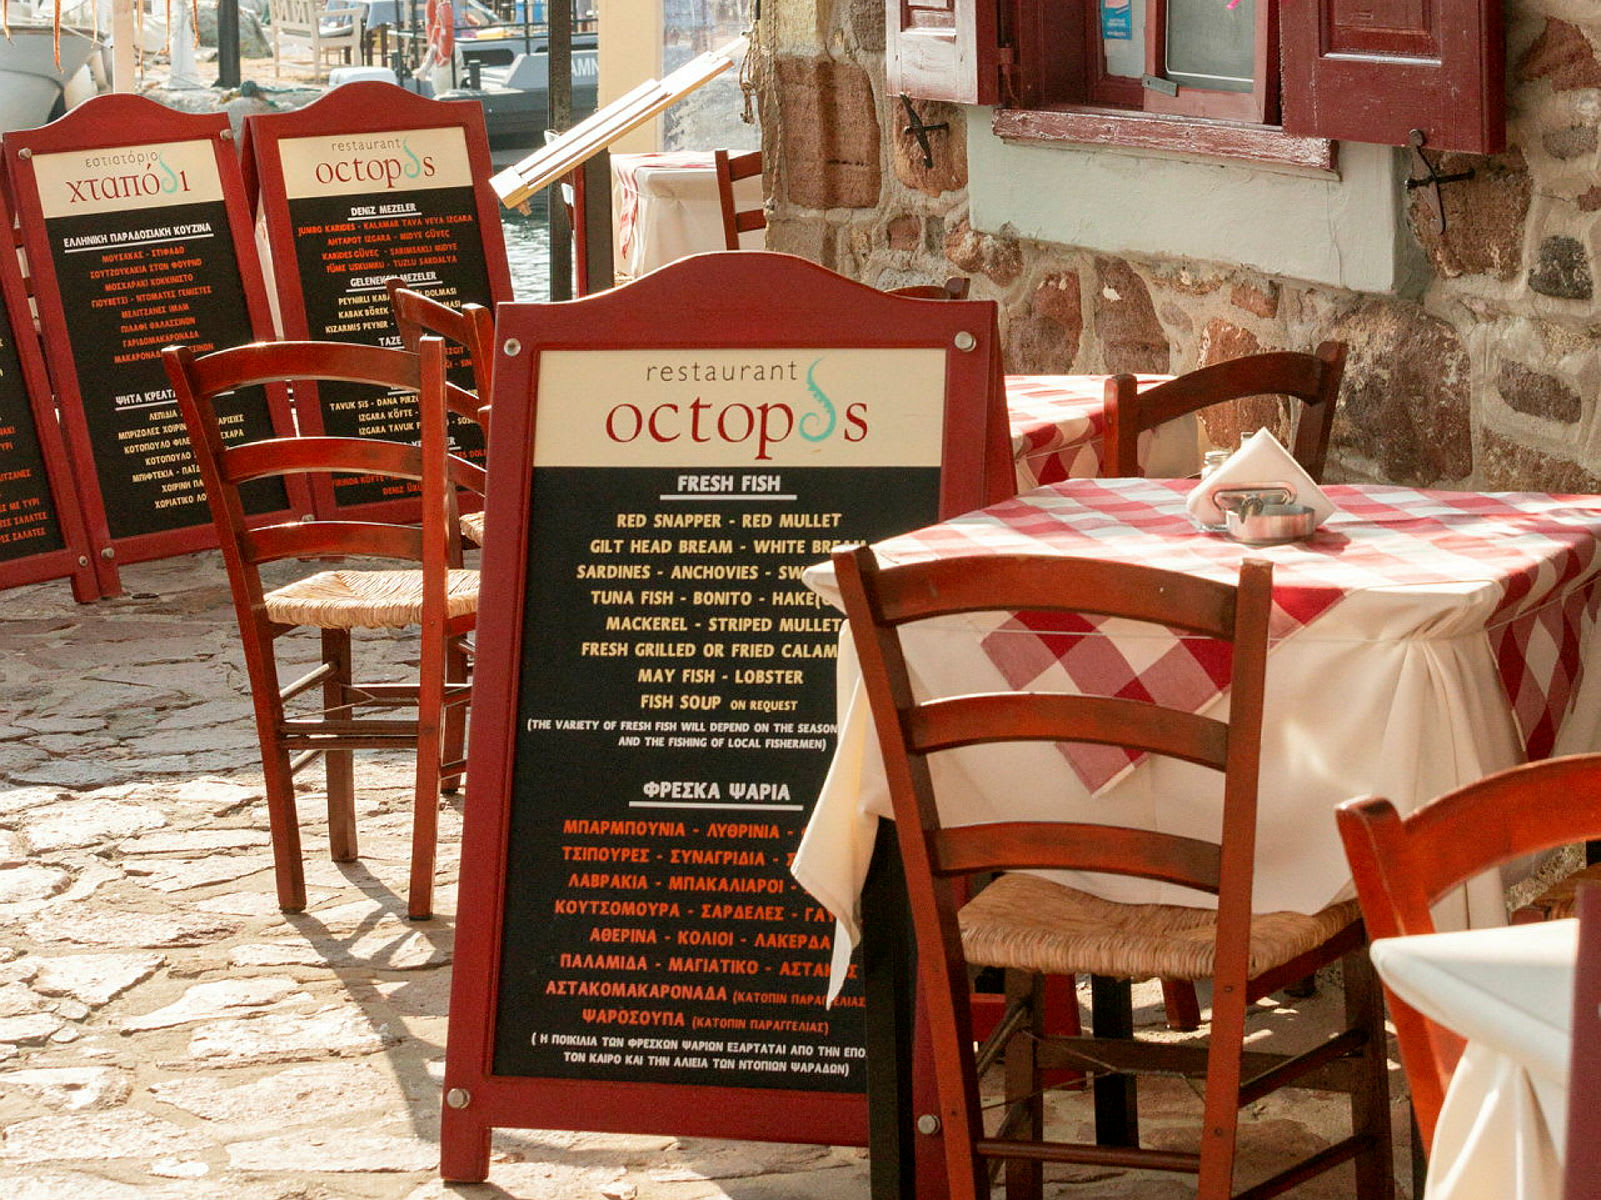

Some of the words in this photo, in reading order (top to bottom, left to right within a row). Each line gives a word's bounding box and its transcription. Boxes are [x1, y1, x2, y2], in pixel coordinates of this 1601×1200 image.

[331, 138, 402, 152] restaurant
[379, 202, 417, 214] MEZELER
[63, 234, 108, 248] ΕΛΛΗΝΙΚΗ
[109, 226, 172, 243] ΠΑΡΑΔΟΣΙΑΚΗ
[173, 222, 212, 236] ΚΟΥΖΙΝΑ
[646, 360, 798, 382] restaurant
[677, 474, 734, 492] FRESH
[741, 474, 781, 492] FISH
[616, 513, 647, 528] RED
[653, 513, 722, 528] SNAPPER
[742, 513, 773, 528] RED
[779, 512, 842, 529] MULLET
[590, 539, 625, 554] GILT
[630, 539, 673, 554] HEAD
[678, 539, 733, 554] BREAM
[753, 539, 806, 554] WHITE
[576, 564, 651, 580] SARDINES
[670, 565, 759, 580] ANCHOVIES
[590, 590, 635, 605] TUNA
[640, 590, 674, 605] FISH
[692, 591, 753, 606] BONITO
[605, 616, 688, 632] MACKEREL
[708, 617, 773, 632] STRIPED
[779, 617, 843, 633] MULLET
[581, 641, 629, 657] FRESH
[634, 642, 696, 658] GRILLED
[702, 643, 724, 658] OR
[731, 643, 775, 658] FRIED
[637, 668, 676, 683] MAY
[682, 668, 716, 684] FISH
[734, 669, 804, 685] LOBSTER
[640, 694, 674, 709] FISH
[679, 694, 722, 711] SOUP
[729, 699, 747, 711] ON
[749, 700, 799, 713] REQUEST
[527, 718, 552, 732] (THE
[555, 719, 600, 731] VARIETY
[603, 720, 617, 731] OF
[620, 720, 652, 731] FRESH
[654, 721, 678, 732] FISH
[680, 721, 706, 733] WILL
[709, 722, 750, 733] DEPEND
[753, 722, 770, 733] ON
[772, 722, 794, 734] THE
[618, 736, 641, 747] AND
[644, 736, 665, 747] THE
[668, 736, 708, 748] FISHING
[710, 737, 725, 748] OF
[727, 737, 762, 749] LOCAL
[765, 738, 827, 752] FISHERMEN)
[643, 781, 721, 800] ΦΡΕΣΚΑ
[728, 782, 791, 801] ΨΑΡΙΑ
[563, 819, 686, 837] ΜΠΑΡΜΠΟΥΝΙΑ
[706, 823, 780, 839] ΛΥΘΡΙΝΙΑ
[561, 845, 650, 863] ΤΣΙΠΟΥΡΕΣ
[670, 849, 765, 866] ΣΥΝΑΓΡΙΔΙΑ
[568, 873, 648, 890] ΛΑΒΡΑΚΙΑ
[668, 875, 784, 894] ΜΠΑΚΑΛΙΑΡΟΙ
[554, 899, 680, 917] ΚΟΥΤΣΟΜΟΥΡΑ
[700, 903, 785, 921] ΣΑΡΔΕΛΕΣ
[589, 927, 657, 944] ΑΘΕΡΙΝΑ
[677, 930, 734, 947] ΚΟΛΙΟΙ
[754, 932, 831, 950] ΛΑΚΕΡΔΑ
[560, 953, 648, 971] ΠΑΛΑΜΙΔΑ
[668, 956, 759, 975] ΜΑΓΙΑΤΙΚΟ
[545, 980, 727, 1001] ΑΣΤΑΚΟΜΑΚΑΡΟΝΑΔΑ
[582, 1008, 685, 1027] ΨΑΡΟΣΟΥΠΑ
[539, 1033, 549, 1044] Η
[551, 1034, 598, 1047] ΠΟΙΚΙΛΙΑ
[601, 1036, 625, 1048] ΤΩΝ
[627, 1038, 679, 1050] ΦΡΕΣΚΩΝ
[681, 1040, 724, 1052] ΨΑΡΙΩΝ
[727, 1041, 787, 1055] ΕΞΑΡΤΑΤΑΙ
[790, 1044, 814, 1056] ΑΠΟ
[817, 1045, 841, 1057] ΤΗΝ
[563, 1051, 586, 1063] ΤΟΝ
[588, 1052, 622, 1065] ΚΑΙΡΟ
[624, 1054, 644, 1066] ΚΑΙ
[647, 1055, 671, 1067] ΤΗΝ
[673, 1056, 709, 1069] ΑΛΙΕΙΑ
[712, 1058, 736, 1070] ΤΩΝ
[738, 1059, 787, 1072] ΝΤΟΠΙΩΝ
[790, 1061, 850, 1077] ΨΑΡΑΔΩΝ)
